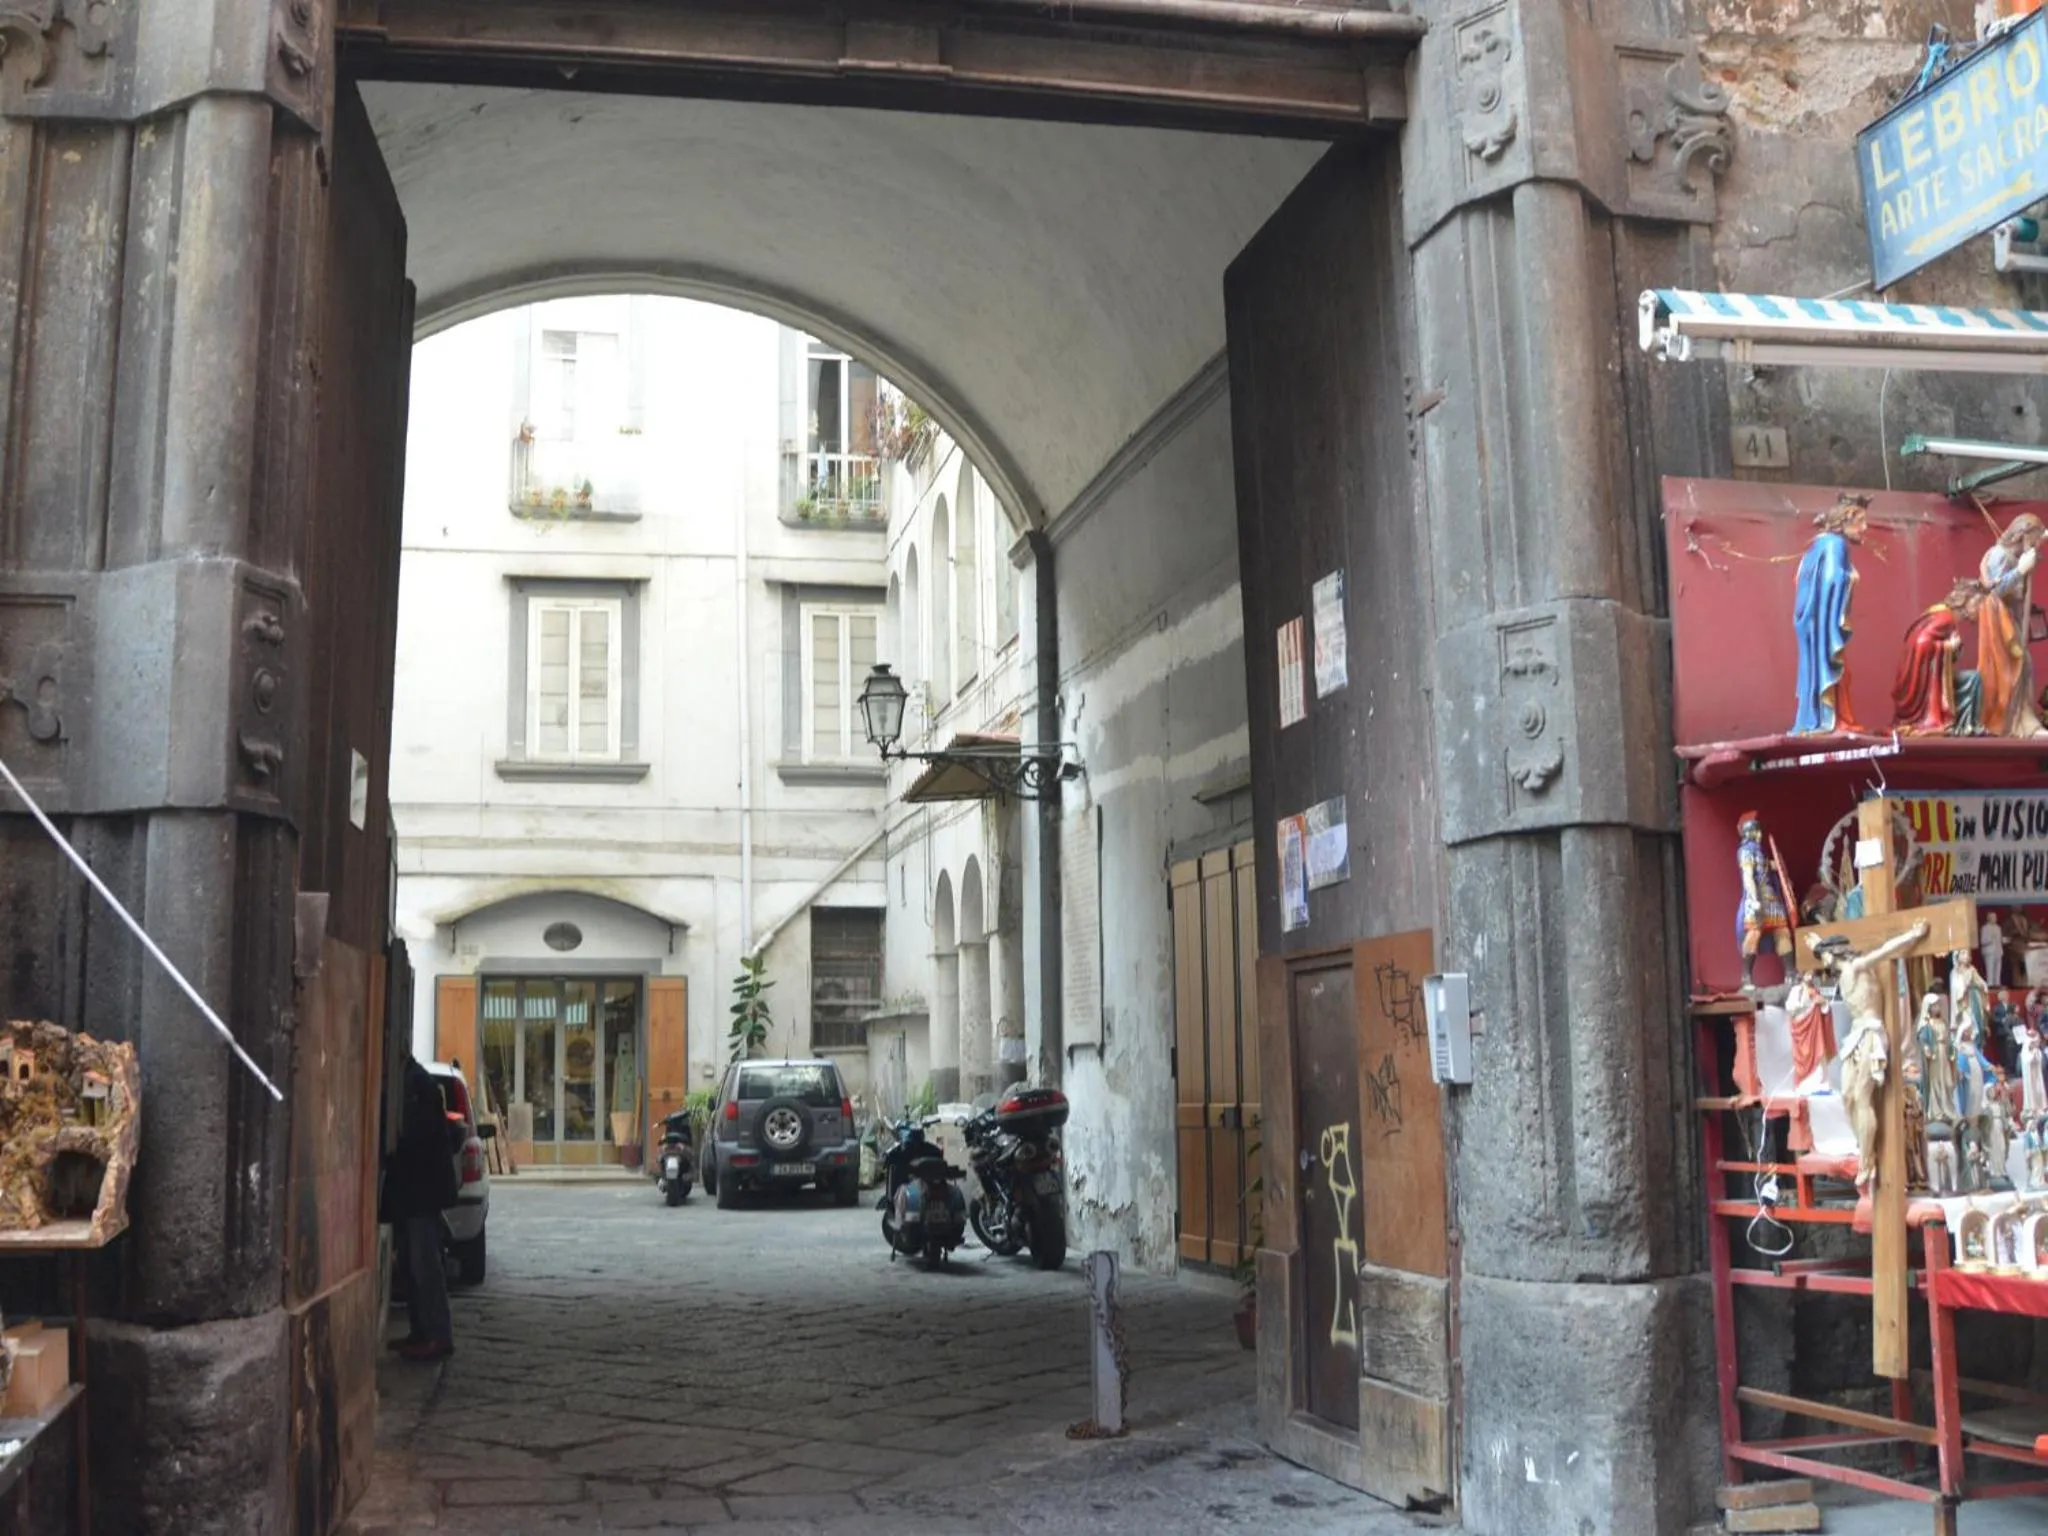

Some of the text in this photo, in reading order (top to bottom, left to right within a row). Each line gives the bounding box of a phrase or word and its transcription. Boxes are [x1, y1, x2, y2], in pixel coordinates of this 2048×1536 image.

[1871, 37, 2040, 190] LEBRO
[1881, 104, 2048, 240] ARTE SACRA
[1746, 433, 1772, 459] 41
[1977, 852, 2017, 892] MANI
[2021, 851, 2048, 892] PU
